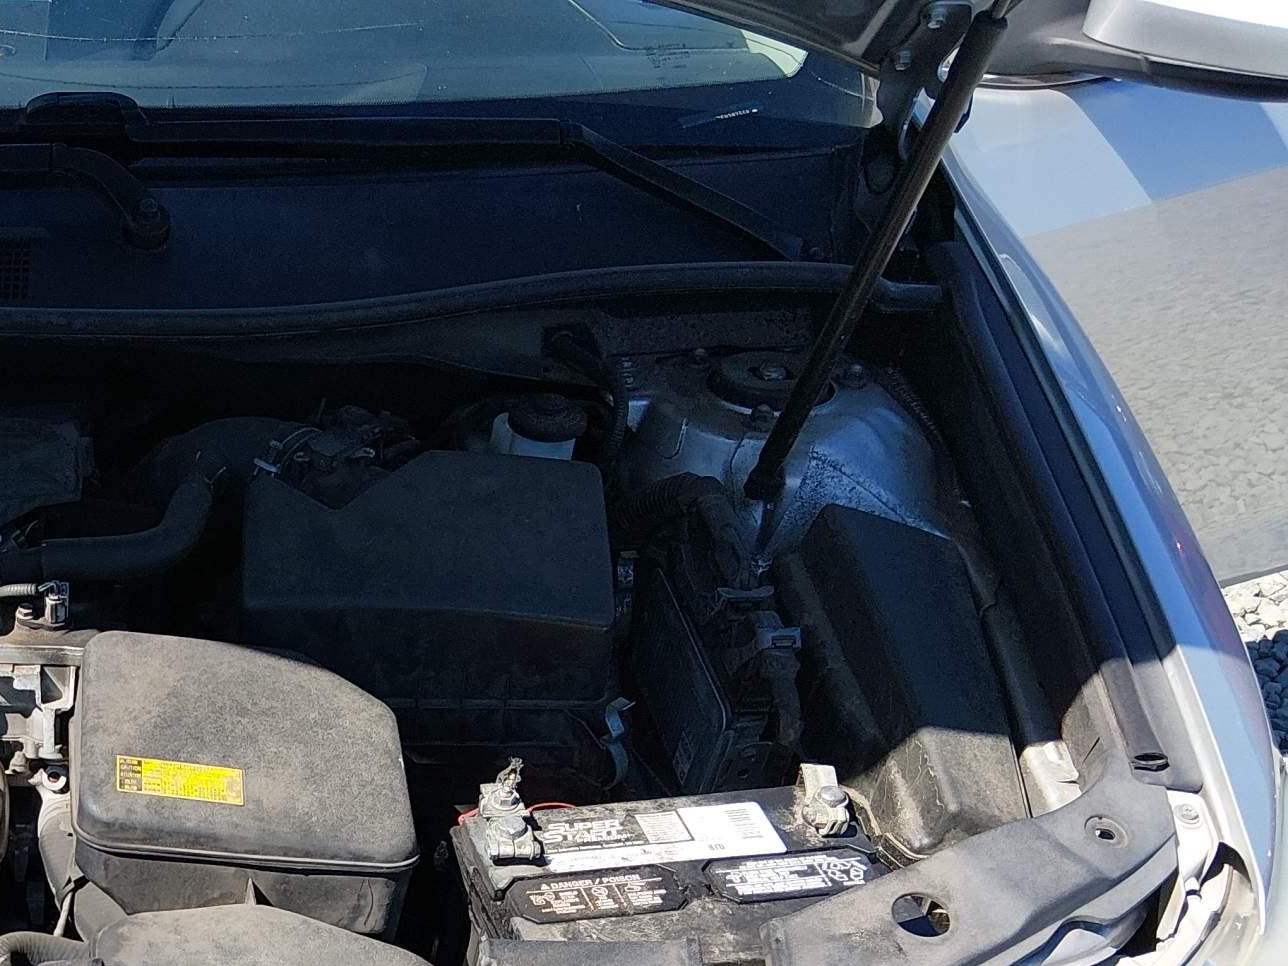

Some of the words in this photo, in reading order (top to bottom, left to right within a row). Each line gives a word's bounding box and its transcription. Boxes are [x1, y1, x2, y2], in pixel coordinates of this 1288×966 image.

[547, 819, 624, 833] SUPER
[543, 827, 623, 844] START
[550, 879, 593, 891] DANGER
[602, 873, 641, 884] POISON
